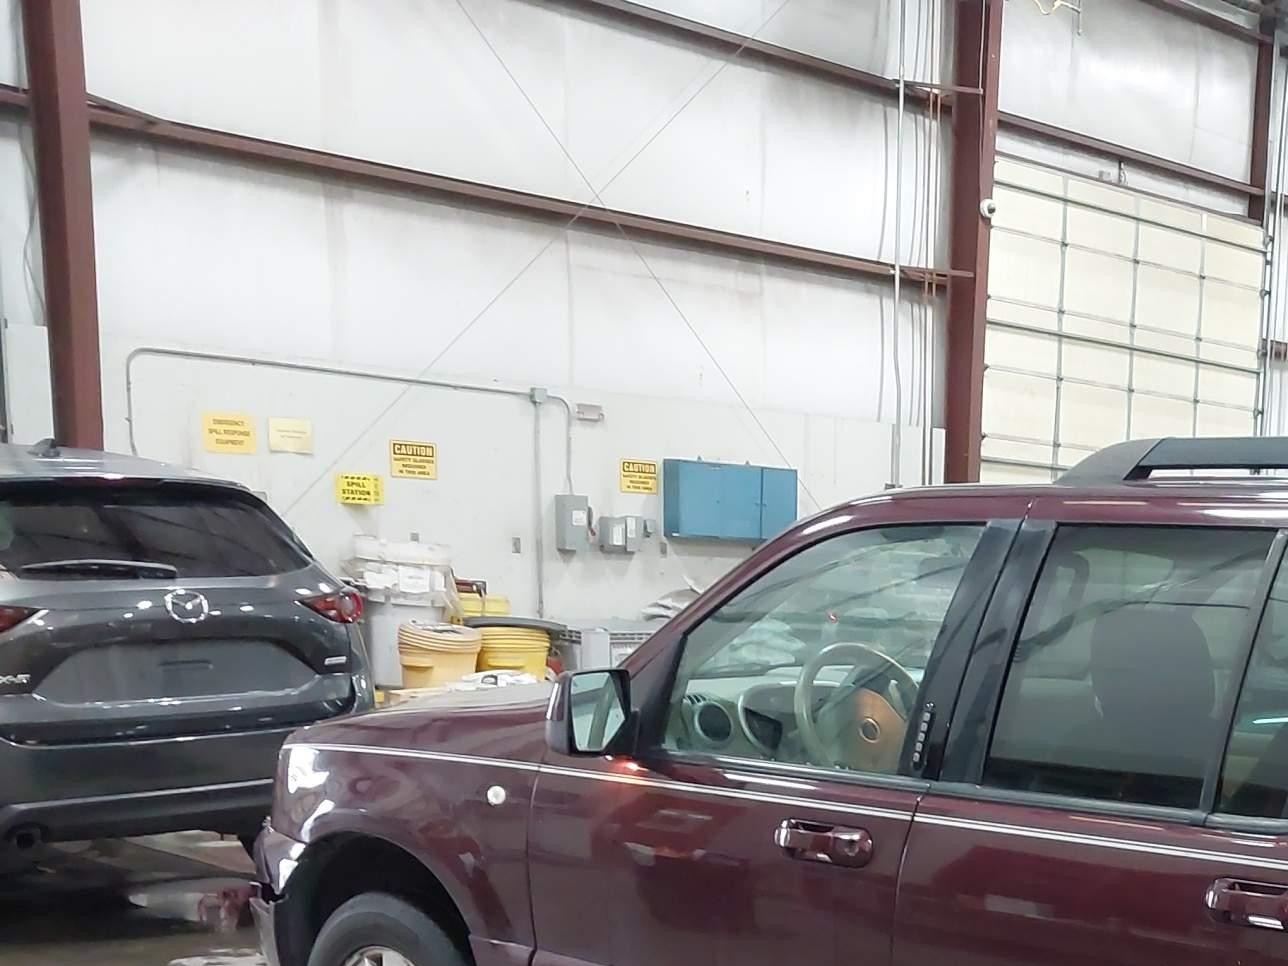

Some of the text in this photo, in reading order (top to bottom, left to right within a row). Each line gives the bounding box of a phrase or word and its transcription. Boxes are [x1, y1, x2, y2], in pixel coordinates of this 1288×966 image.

[394, 444, 433, 457] CAUTION
[623, 462, 655, 473] CAUTION
[342, 488, 371, 496] STATION
